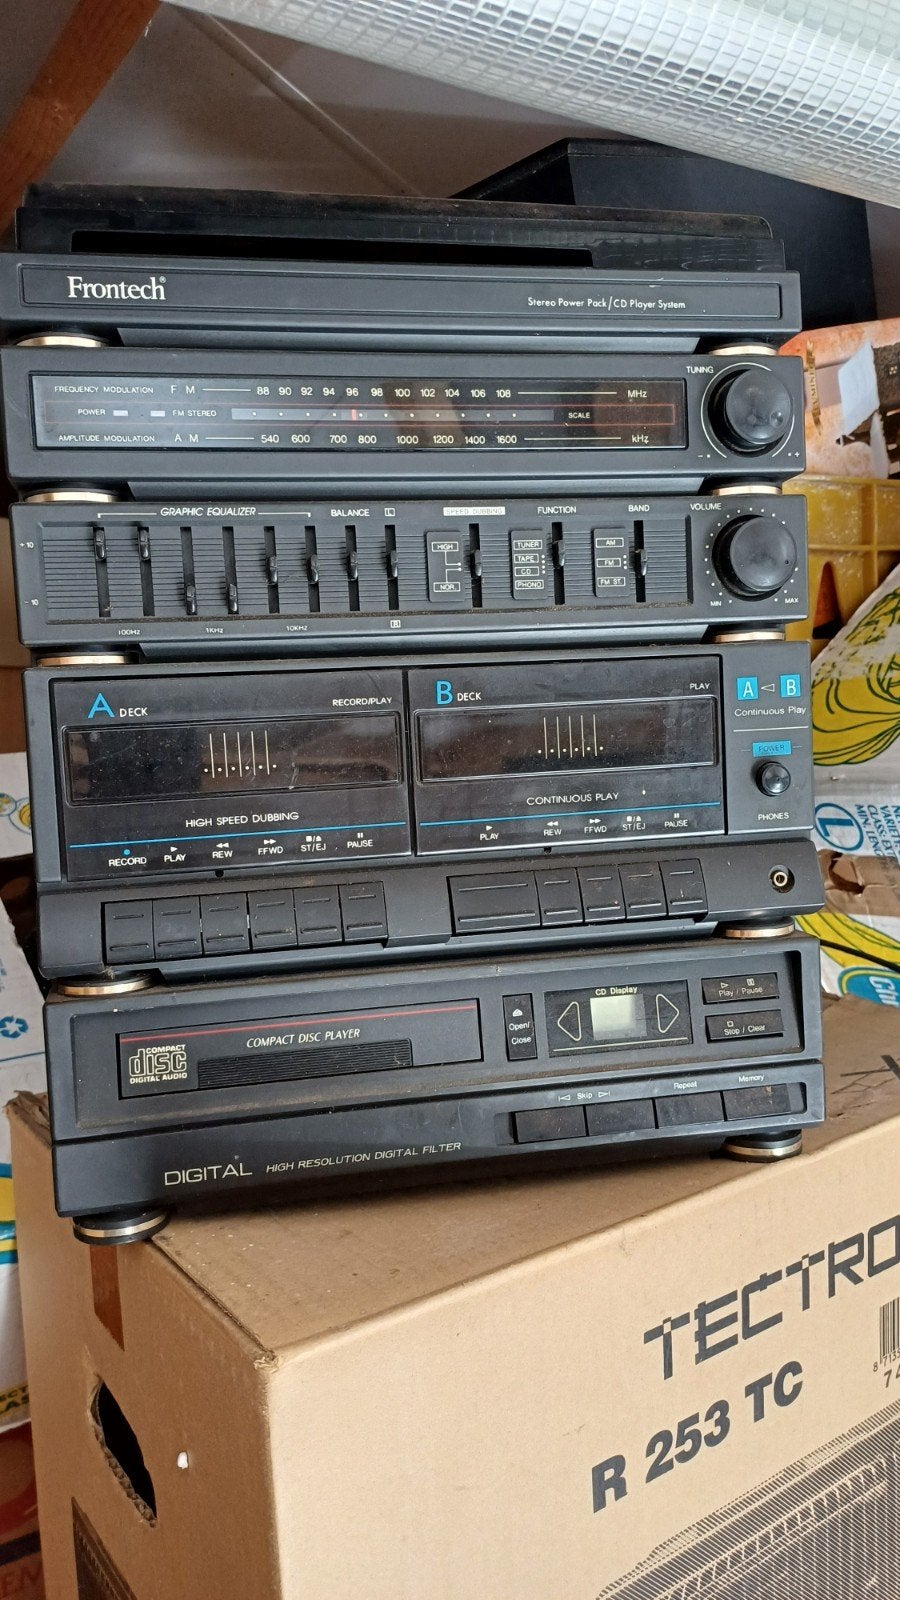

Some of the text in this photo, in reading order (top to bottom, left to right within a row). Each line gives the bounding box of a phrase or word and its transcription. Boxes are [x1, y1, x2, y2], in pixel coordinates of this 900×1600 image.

[528, 297, 556, 307] Stereo
[558, 298, 584, 308] Power
[630, 299, 656, 310] Player
[658, 300, 686, 310] System
[686, 366, 714, 374] TUNING
[54, 386, 99, 394] FREQUENCY
[103, 386, 154, 394] MODULATION
[256, 386, 270, 396] 88
[278, 386, 292, 396] 90
[301, 386, 313, 396] 92
[323, 387, 335, 396] 94
[346, 387, 359, 397] 96
[371, 388, 384, 397] 98
[394, 388, 411, 397] 100
[420, 388, 436, 398] 102
[444, 389, 460, 398] 104
[470, 389, 486, 398] 106
[495, 389, 511, 398] 108
[627, 389, 648, 398] MHz
[77, 408, 106, 416] POWER
[260, 434, 280, 443] 540
[291, 434, 310, 443] 600
[329, 435, 347, 444] 700
[358, 435, 377, 444] 800
[396, 435, 419, 444] 1000
[433, 435, 455, 444] 1200
[464, 435, 486, 444] 1400
[496, 435, 518, 444] 1600
[631, 435, 649, 444] kHz
[160, 507, 257, 516] GRAPHIC EQUALIZER
[537, 506, 577, 515] FUNCTION
[628, 505, 650, 513] BAND
[689, 503, 722, 511] VOLUME
[330, 509, 370, 517] BALANCE
[689, 682, 710, 691] PLAY
[743, 679, 796, 698] A B
[436, 681, 481, 705] B DECK
[87, 692, 148, 719] A DECK
[332, 697, 392, 707] RECORD/PLAY
[734, 706, 806, 717] Continuous Play
[758, 744, 785, 752] POWER
[526, 792, 619, 806] CONTINUOUS PLAY
[185, 812, 299, 828] HIGH SPEED DUBBING
[758, 812, 790, 821] PHONES
[480, 820, 688, 841] PLAY REW FFWD ST/EJ PAUSE
[108, 839, 373, 867] RECORD PLAY REW FFWD ST/EJ PAUSE
[595, 986, 638, 996] CD Display
[718, 990, 734, 998] Play
[742, 986, 763, 995] Pause
[724, 1028, 740, 1036] Stop
[748, 1024, 766, 1033] Clear
[246, 1028, 360, 1048] COMPACT DISC PLAYER
[511, 1035, 532, 1045] Close
[146, 1044, 186, 1054] COMPACT
[130, 1072, 188, 1084] DIGITAL AUDIO
[738, 1073, 765, 1083] Memory
[673, 1081, 698, 1090] Repeat
[577, 1091, 593, 1101] Skip
[164, 1142, 462, 1186] DIGITAL HIGH RESOLUTION DIGITAL FILTER
[591, 1360, 803, 1514] R 253 TC
